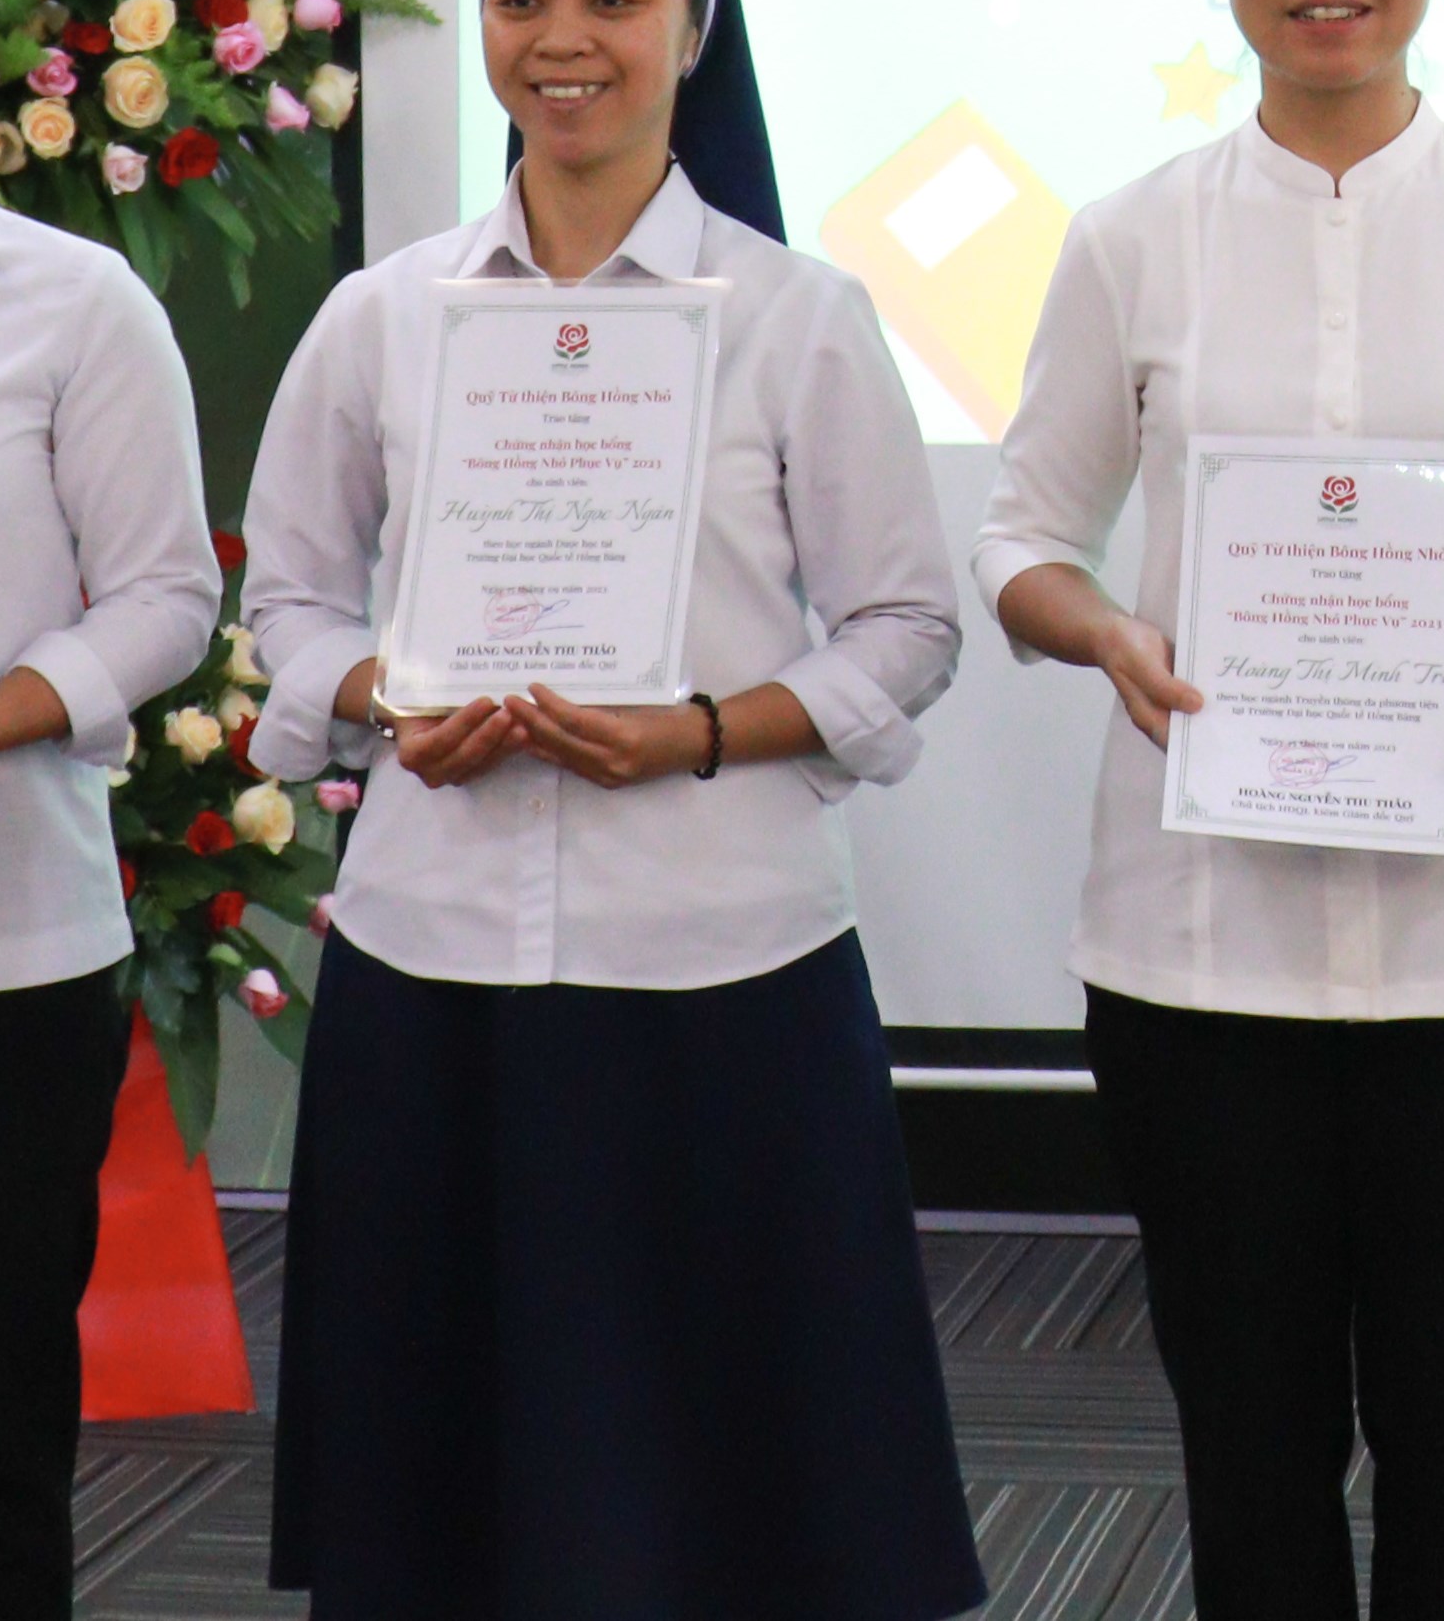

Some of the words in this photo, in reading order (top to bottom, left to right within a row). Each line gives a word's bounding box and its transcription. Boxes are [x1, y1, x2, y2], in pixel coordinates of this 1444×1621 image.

[1410, 618, 1443, 630] 2023
[1216, 655, 1292, 690] Hoàng
[1339, 659, 1412, 683] Minh
